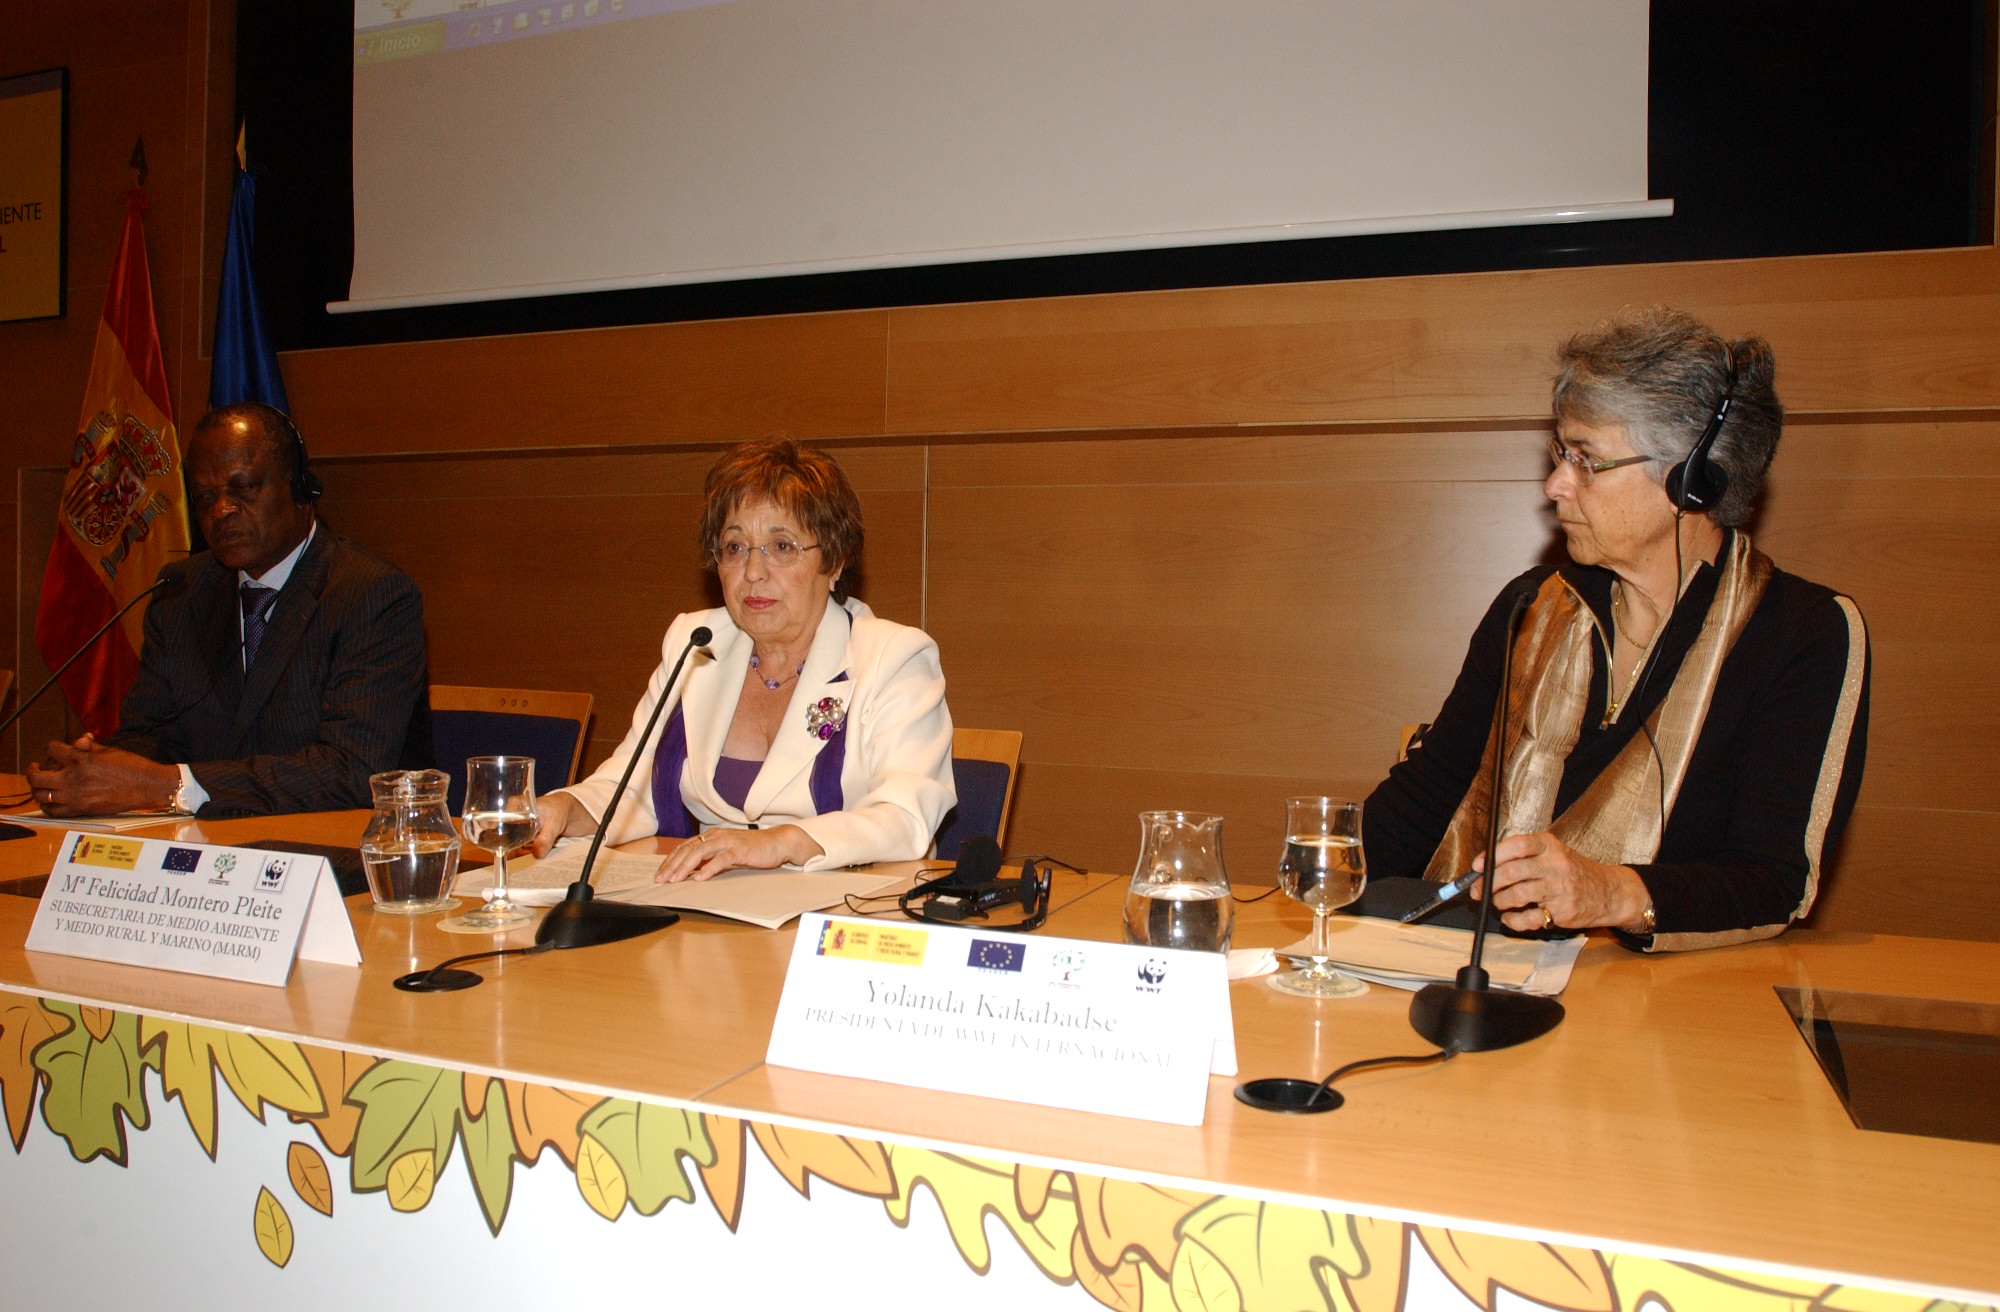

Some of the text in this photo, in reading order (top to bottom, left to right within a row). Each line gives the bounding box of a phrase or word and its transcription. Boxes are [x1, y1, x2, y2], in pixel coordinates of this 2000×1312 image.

[61, 874, 283, 920] Mª Felicidad Montero Pleite
[50, 899, 280, 942] SUBSECRETARIA DE MEDIO AMBIENTE
[55, 918, 261, 962] Y MEDIO RURAL Y MARINO (MARM)
[867, 980, 1118, 1032] Yolanda Kakabadse
